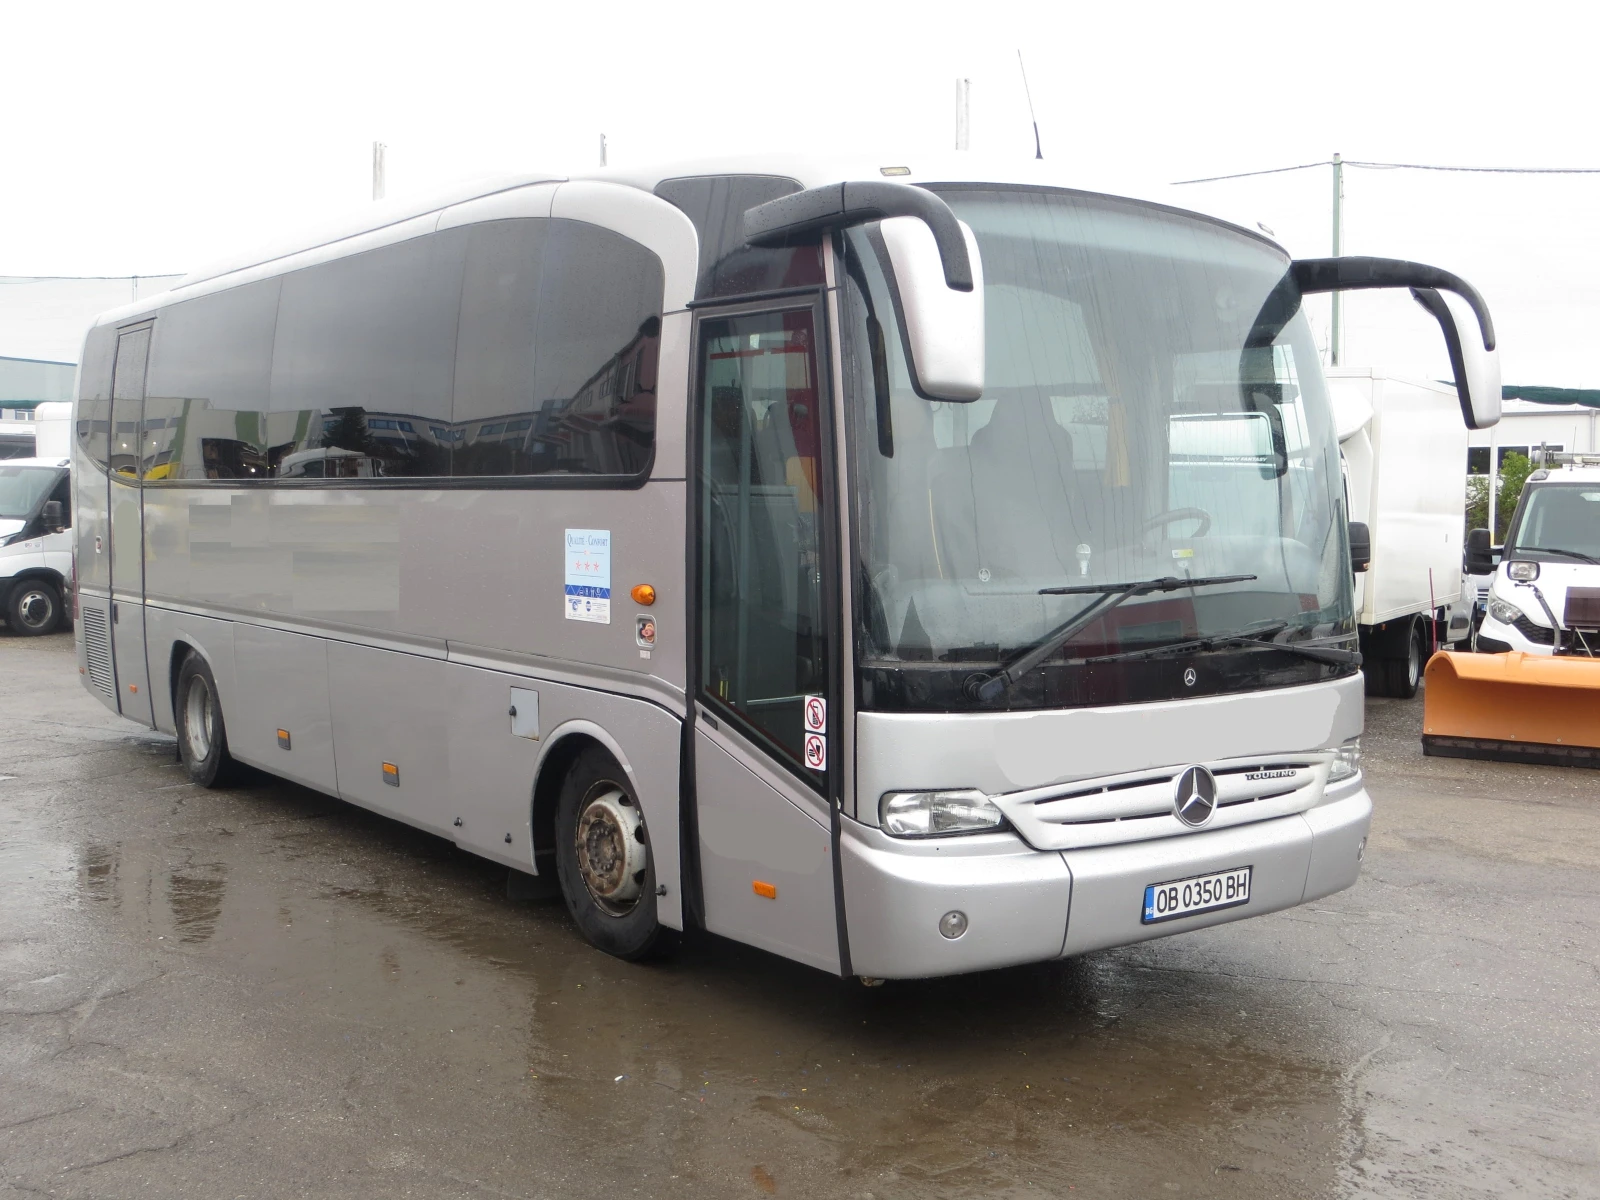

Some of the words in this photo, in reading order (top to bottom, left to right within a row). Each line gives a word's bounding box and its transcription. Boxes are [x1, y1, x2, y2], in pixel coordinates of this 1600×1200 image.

[1245, 770, 1296, 781] TOURINO
[1157, 887, 1178, 913] OB
[1183, 878, 1223, 908] 0350
[1226, 873, 1247, 899] BH
